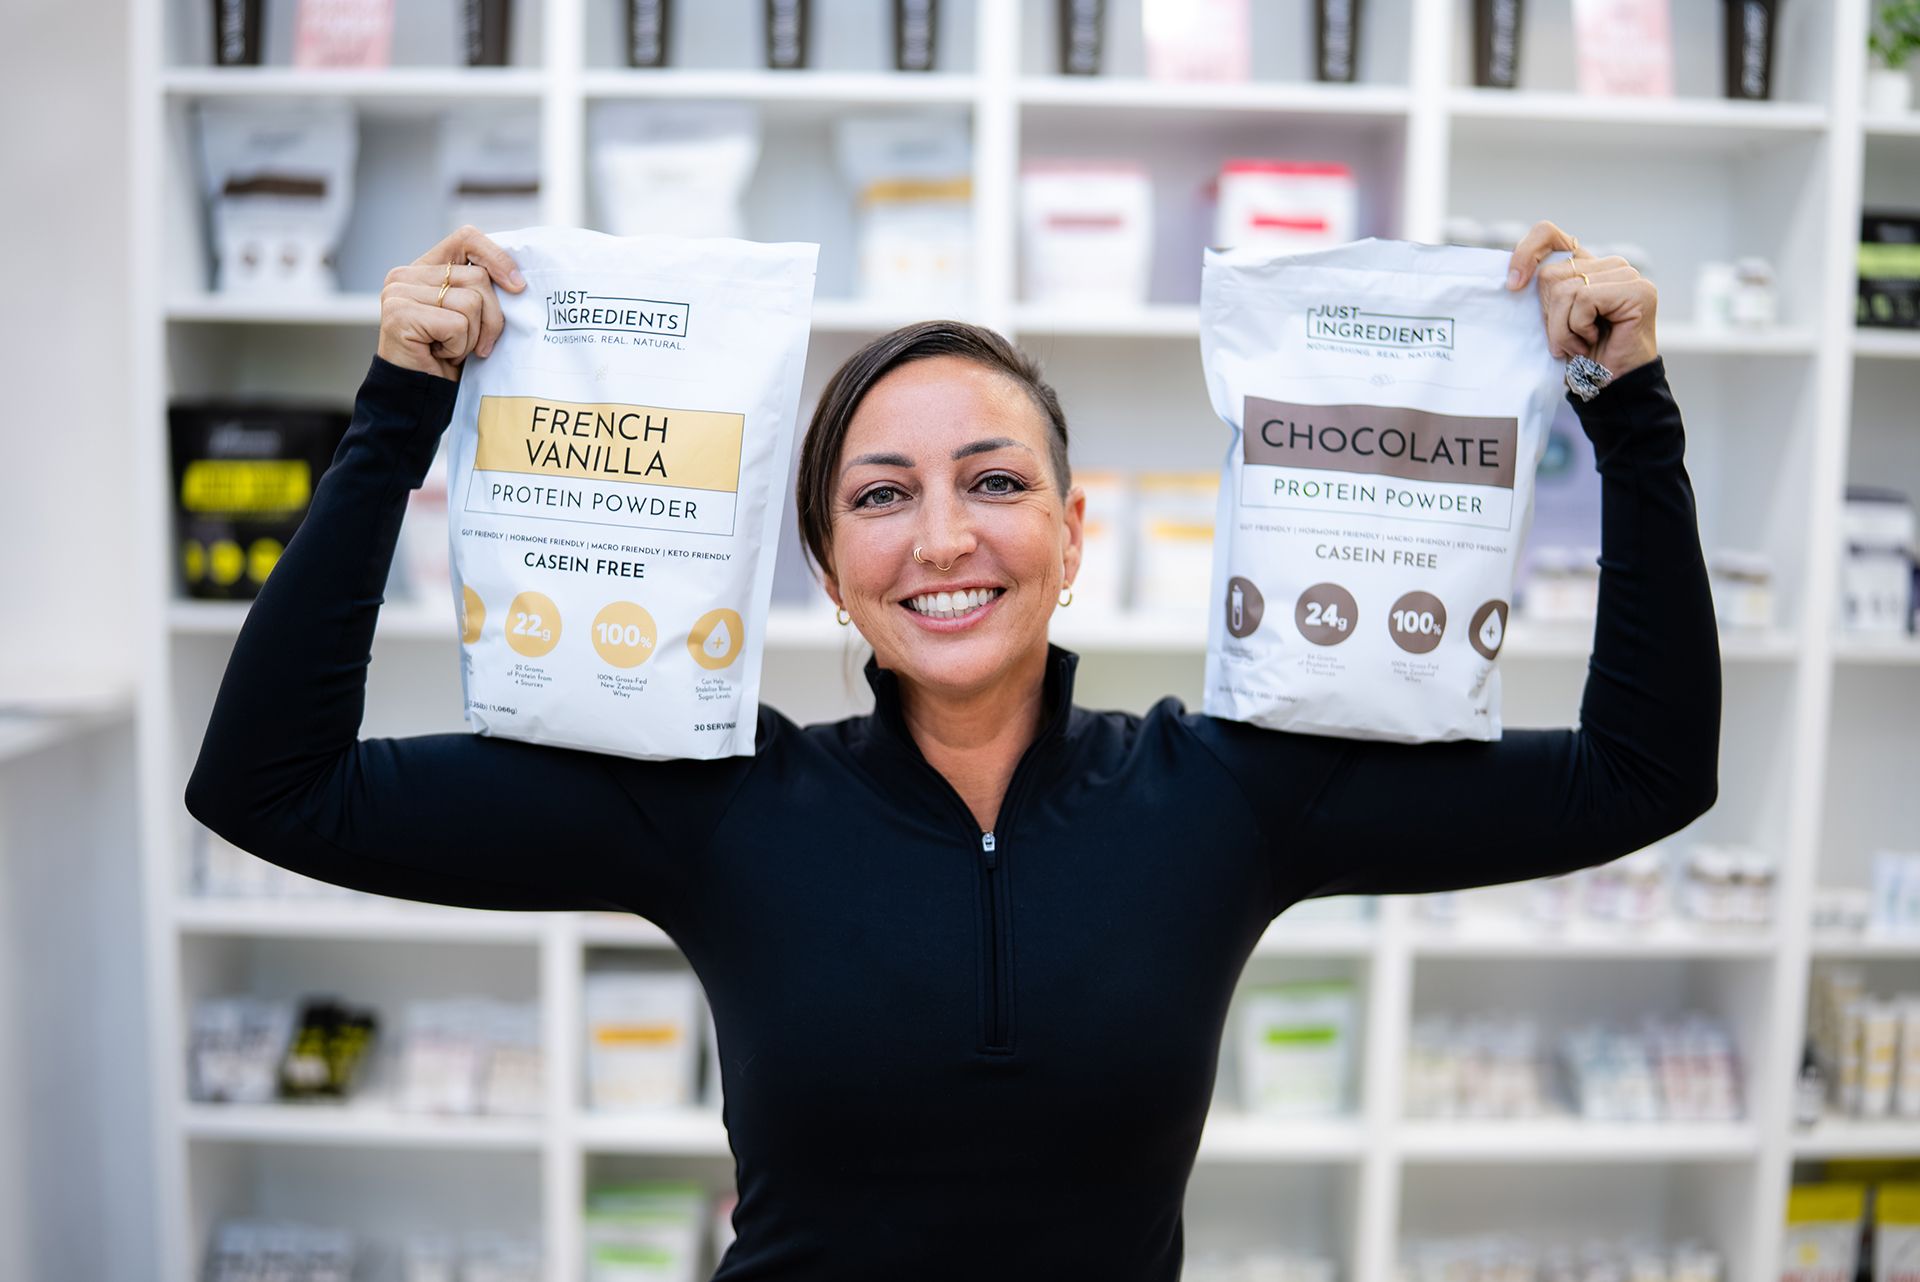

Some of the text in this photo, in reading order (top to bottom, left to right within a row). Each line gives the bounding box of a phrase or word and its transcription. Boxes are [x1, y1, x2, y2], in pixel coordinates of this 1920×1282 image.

[552, 290, 587, 305] JUST
[554, 308, 678, 330] INGREDIENTS
[1316, 304, 1360, 320] JUST
[543, 334, 686, 351] NOURISHING. REAL. NATURAL.
[1317, 320, 1447, 343] INGREDIENTS
[532, 406, 668, 443] FRENCH
[1261, 419, 1499, 468] CHOCOLATE
[526, 438, 668, 478] VANILLA
[492, 484, 697, 519] PROTEIN POWDER
[1273, 479, 1483, 514] PROTEIN POWDER
[461, 528, 731, 560] GUT FRIENDLY HORMONE FRIENDLY MACRO FRIENDLY KETO FRIENDLY
[1315, 544, 1438, 569] CASEIN FREE
[524, 552, 645, 578] CASEIN FREE
[512, 611, 551, 642] 22g
[1305, 602, 1348, 632] 24g
[1392, 609, 1441, 636] 100%
[596, 622, 652, 649] 100%
[597, 674, 613, 682] 100%
[617, 683, 643, 692] Zealand
[613, 690, 631, 699] Whey
[694, 723, 705, 732] 30
